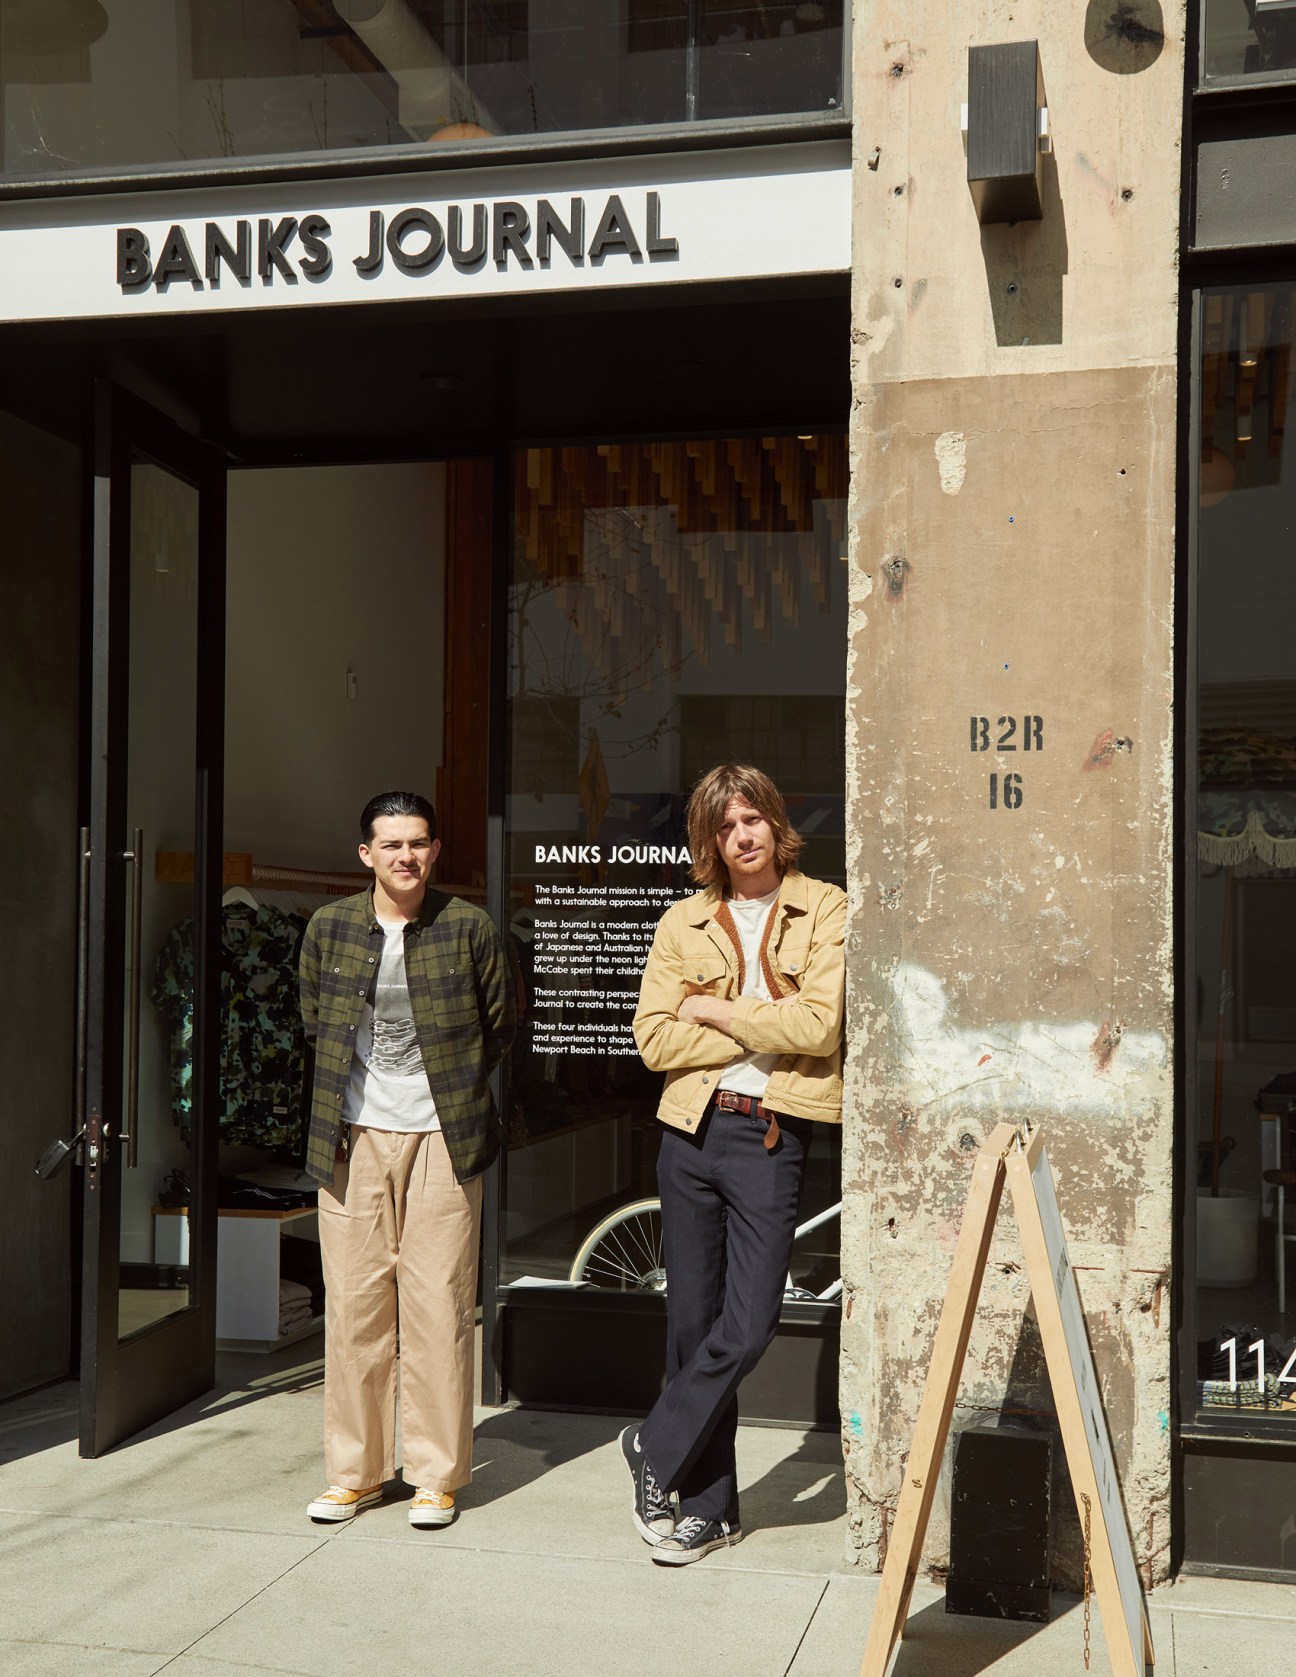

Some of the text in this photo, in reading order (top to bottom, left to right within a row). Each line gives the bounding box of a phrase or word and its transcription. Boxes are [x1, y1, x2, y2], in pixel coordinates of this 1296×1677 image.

[117, 191, 679, 287] BANKS JOURNAL
[970, 715, 1043, 752] B2R
[989, 773, 1022, 809] 16
[536, 846, 695, 864] BANKS JOURNA
[535, 885, 550, 893] The
[552, 885, 574, 894] Banks
[577, 886, 607, 894] Journal
[647, 887, 673, 896] simple
[684, 888, 694, 896] to
[562, 898, 607, 906] sustainable
[609, 898, 649, 907] approach
[535, 919, 557, 928] Banks
[559, 920, 589, 928] Journal
[607, 921, 639, 929] modern
[542, 931, 558, 939] love
[573, 932, 600, 942] design.
[603, 932, 630, 940] Thanks
[546, 942, 583, 952] Japanese
[585, 942, 601, 951] and
[603, 943, 643, 952] Australian
[534, 956, 554, 964] grew
[556, 956, 567, 964] up
[596, 955, 609, 963] the
[534, 965, 568, 973] McCabe
[571, 967, 592, 975] spent
[534, 987, 640, 999] These contrasting perspec
[534, 999, 563, 1007] Journal
[606, 1001, 620, 1009] the
[533, 1021, 556, 1030] These
[578, 1024, 618, 1032] individuals
[533, 1034, 549, 1042] and
[551, 1035, 595, 1043] experience
[609, 1036, 633, 1045] shape
[533, 1044, 568, 1055] Newport
[571, 1045, 596, 1054] Beach
